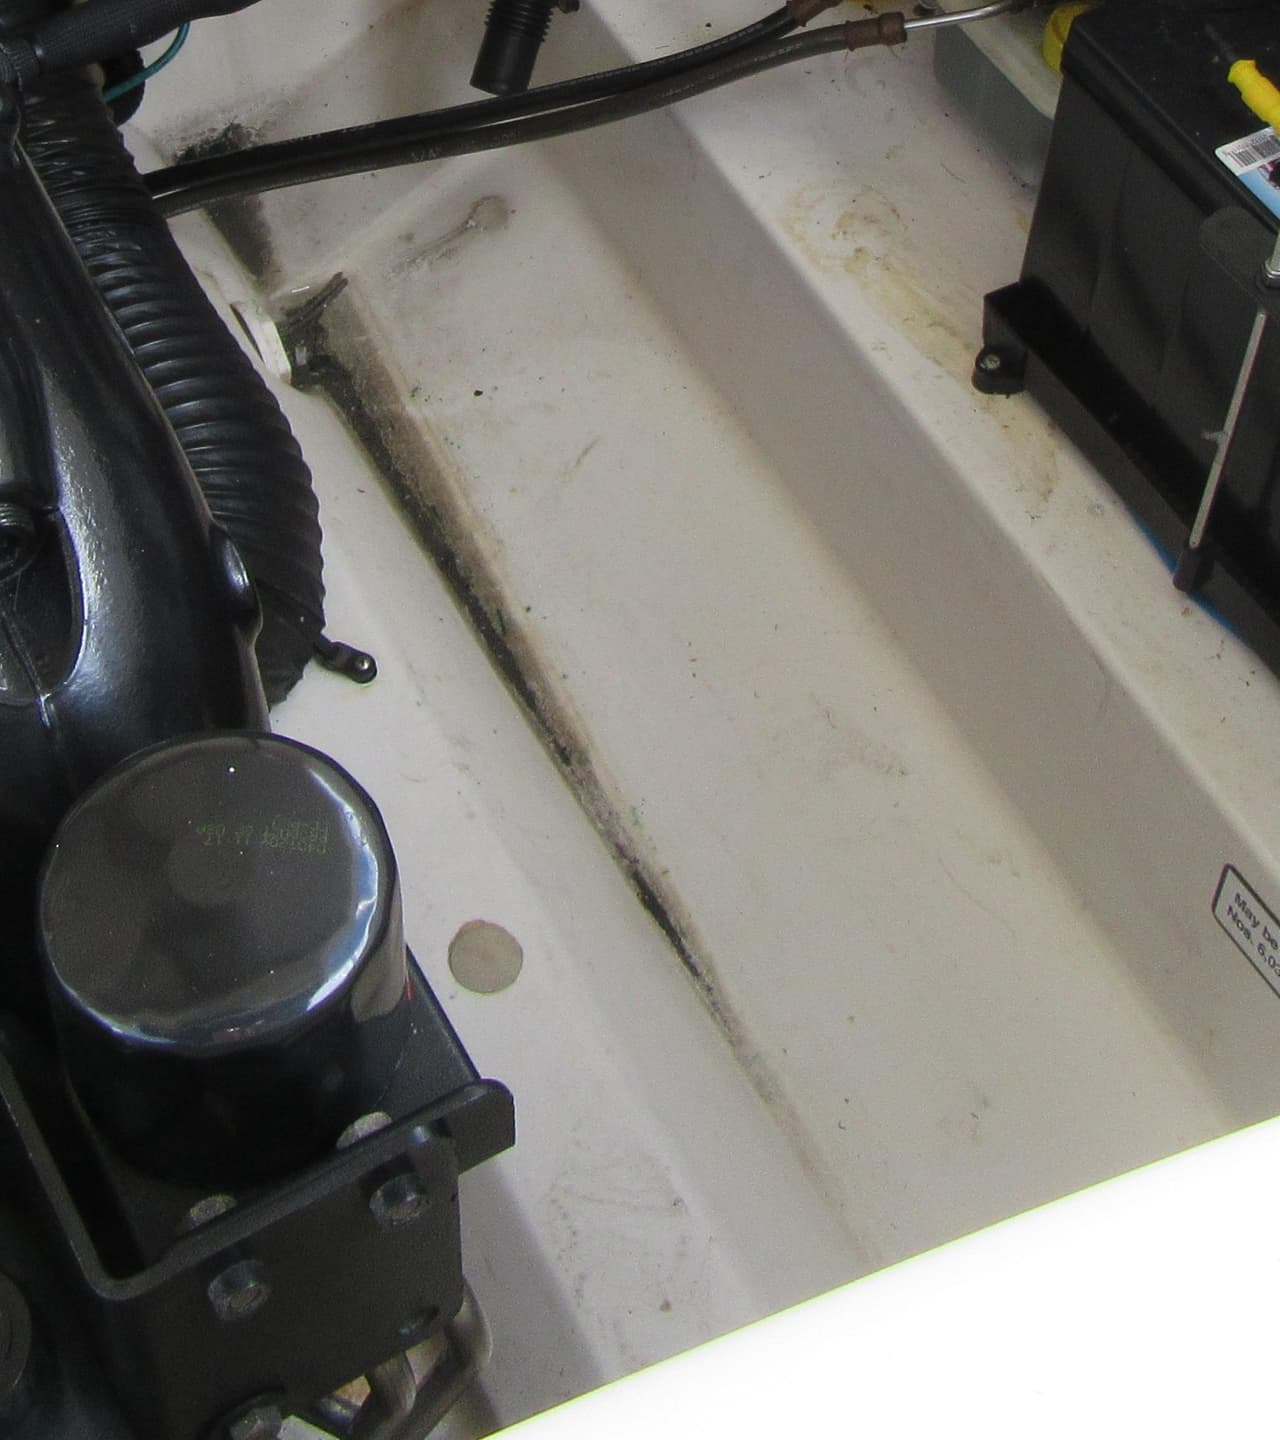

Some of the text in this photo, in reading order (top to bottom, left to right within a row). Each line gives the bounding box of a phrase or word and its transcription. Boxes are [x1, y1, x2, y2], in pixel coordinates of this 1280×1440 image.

[1227, 905, 1254, 945] Nos.
[1234, 893, 1261, 929] May
[1261, 926, 1278, 951] be
